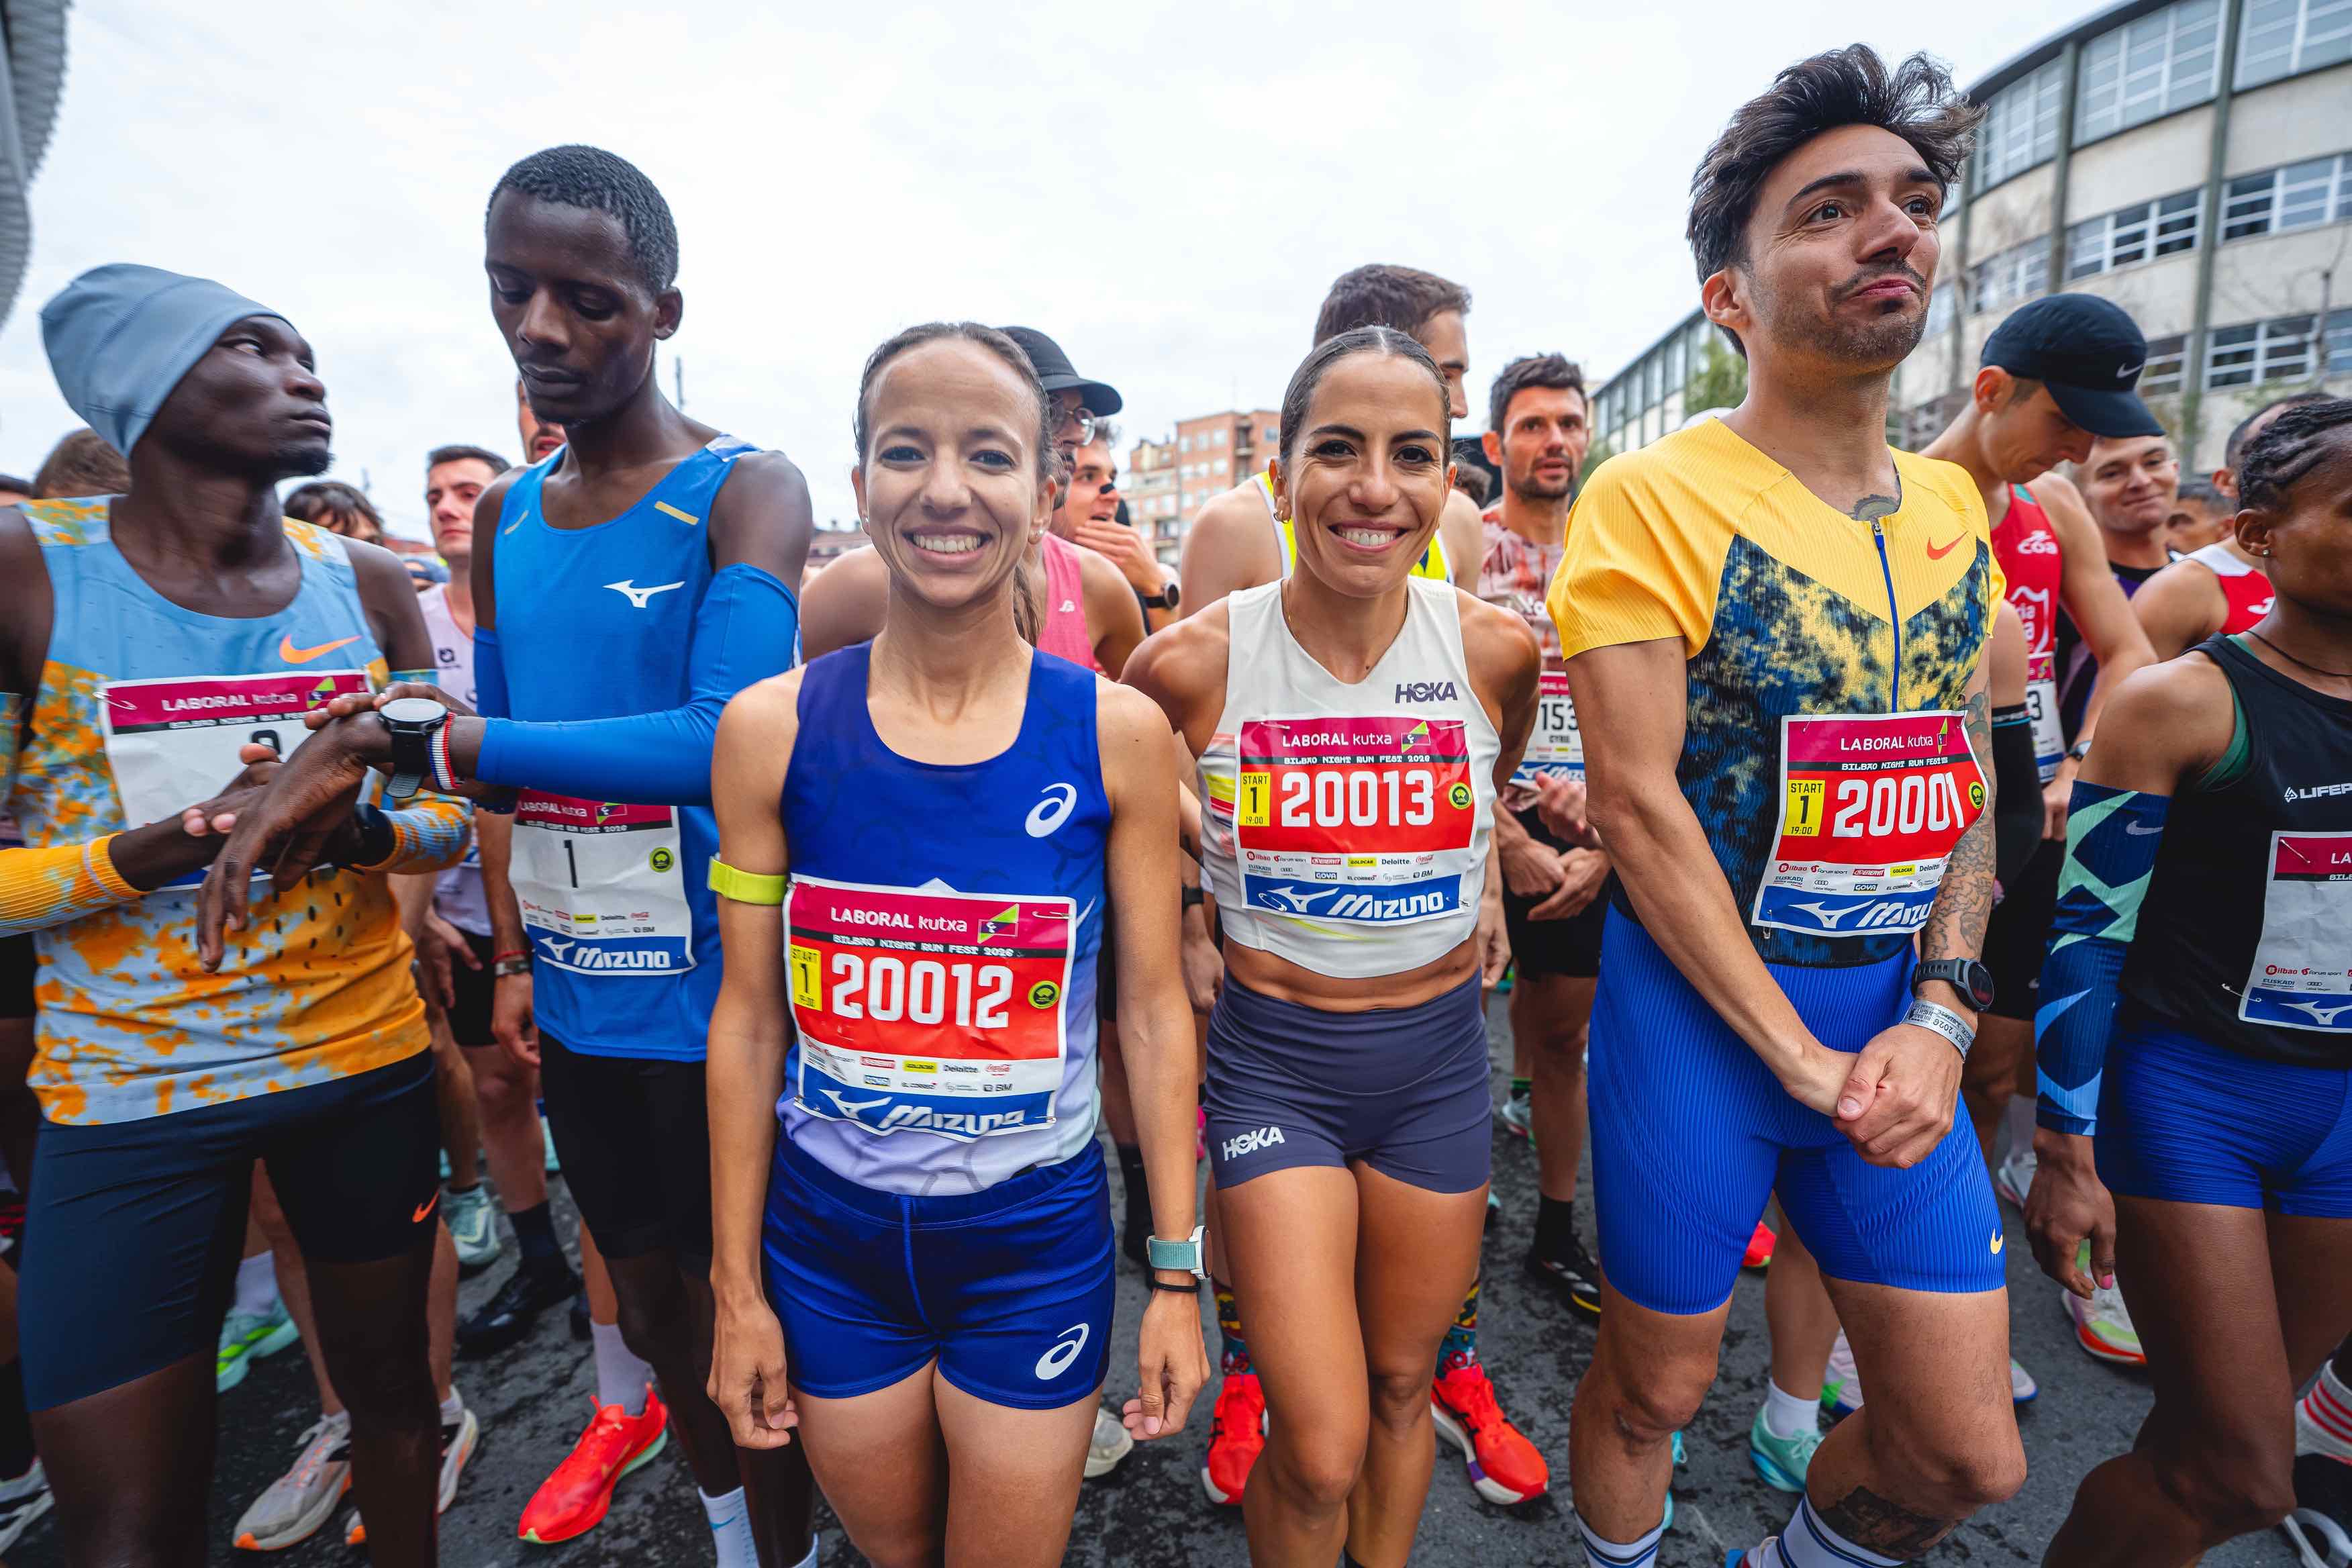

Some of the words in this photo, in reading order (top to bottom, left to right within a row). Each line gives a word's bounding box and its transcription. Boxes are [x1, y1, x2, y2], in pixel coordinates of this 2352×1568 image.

[1395, 681, 1458, 703] HOKA
[162, 693, 252, 712] LABORAL
[1283, 733, 1349, 747] LABORAL
[1353, 732, 1392, 746] kutxa
[1841, 736, 1905, 751] LABORAL
[1907, 734, 1933, 747] kutxa
[1284, 756, 1318, 764] BILBAO
[1322, 756, 1351, 764] NIGHT
[1380, 755, 1402, 763] FEST
[1408, 754, 1430, 763] 2026
[1841, 763, 1877, 771] BILBAO
[1881, 761, 1905, 769] NIGHT
[1908, 759, 1924, 767] RUN
[1926, 758, 1941, 767] FEST
[1242, 775, 1268, 785] START
[1791, 783, 1822, 793] START
[1250, 786, 1258, 814] 1
[1281, 770, 1434, 827] 20013
[1832, 772, 1965, 838] 20001
[1800, 795, 1810, 824] 1
[1245, 816, 1263, 825] 19:00
[1791, 826, 1812, 835] 19:00
[2331, 852, 2352, 864] LA
[1779, 863, 1807, 873] Bilbao
[830, 906, 914, 929] LABORAL
[918, 916, 967, 933] kutxa
[833, 934, 875, 947] BILBAO
[880, 938, 916, 950] NIGHT
[921, 942, 944, 953] RUN
[949, 945, 978, 954] FEST
[2265, 965, 2298, 976] Bilbao
[831, 952, 1014, 1028] 20012
[1222, 1126, 1285, 1161] HOKA
